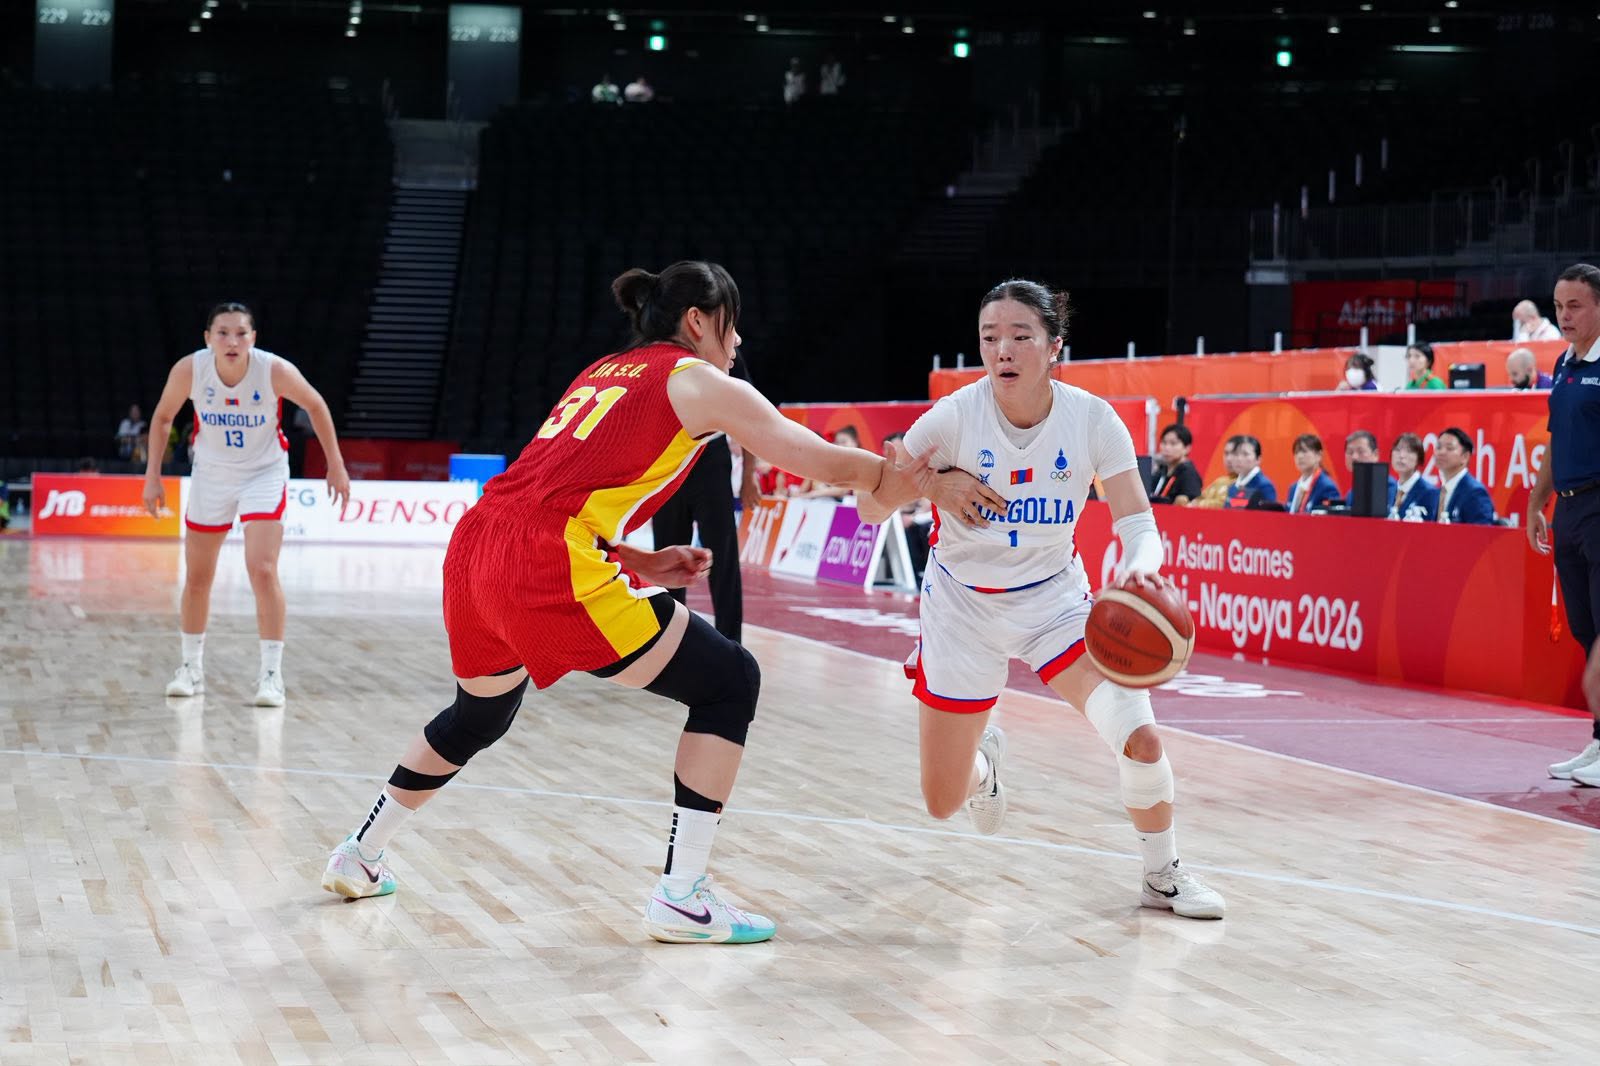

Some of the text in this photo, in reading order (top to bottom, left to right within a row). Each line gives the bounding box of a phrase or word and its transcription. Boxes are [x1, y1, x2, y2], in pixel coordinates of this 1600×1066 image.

[39, 7, 111, 26] 229 229
[201, 411, 266, 428] MONGOLIA
[537, 385, 628, 441] 31
[225, 430, 244, 448] 13
[38, 489, 86, 520] JTB
[339, 500, 468, 525] DENSO
[1008, 530, 1018, 547] 1
[1176, 532, 1223, 573] Asian
[1227, 538, 1294, 580] Games
[1297, 594, 1363, 652] 2026
